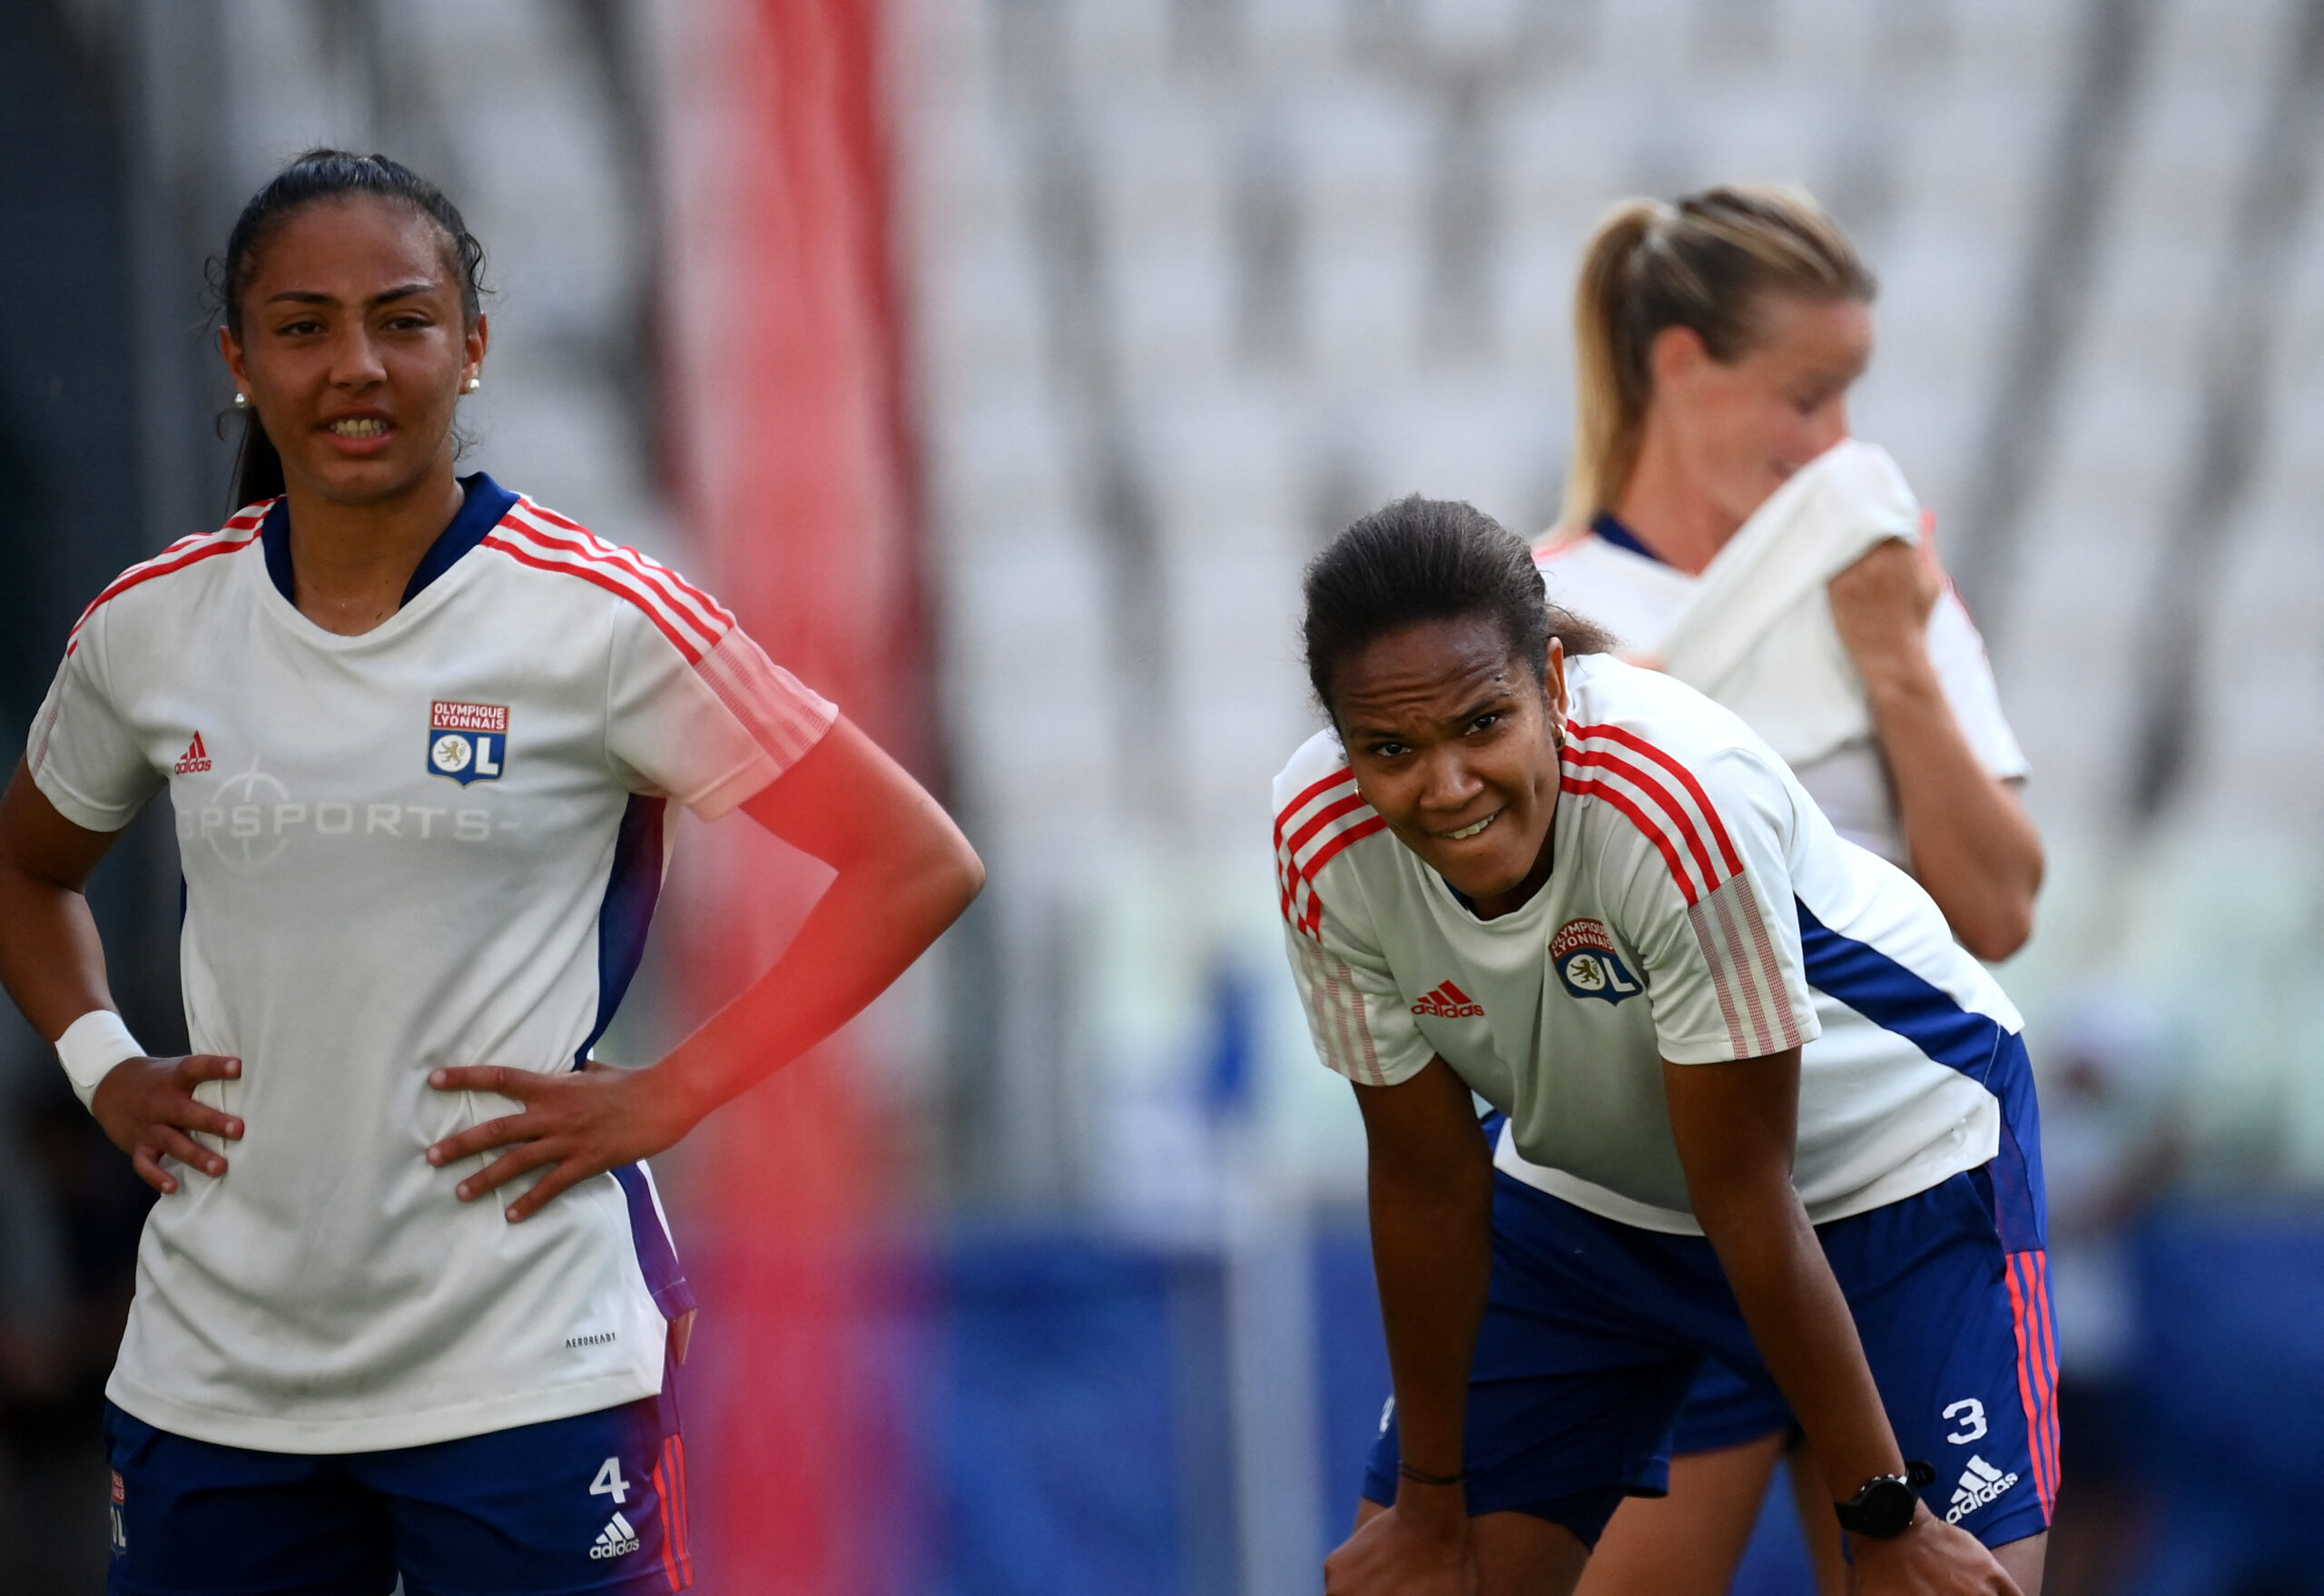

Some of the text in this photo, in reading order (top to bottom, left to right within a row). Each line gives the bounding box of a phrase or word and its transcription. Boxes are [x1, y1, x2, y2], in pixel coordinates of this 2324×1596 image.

[434, 703, 505, 719] OLYMPIQUE
[433, 714, 505, 730] LYONNAIS
[174, 758, 212, 774] adidas
[1553, 932, 1615, 958] LYONNAIS
[1411, 1001, 1485, 1019] adidas
[566, 1332, 616, 1349] AEROREADY
[1942, 1397, 1988, 1445] 3
[589, 1455, 630, 1504] 4
[1945, 1472, 2019, 1525] adidas
[589, 1538, 640, 1560] adidas
